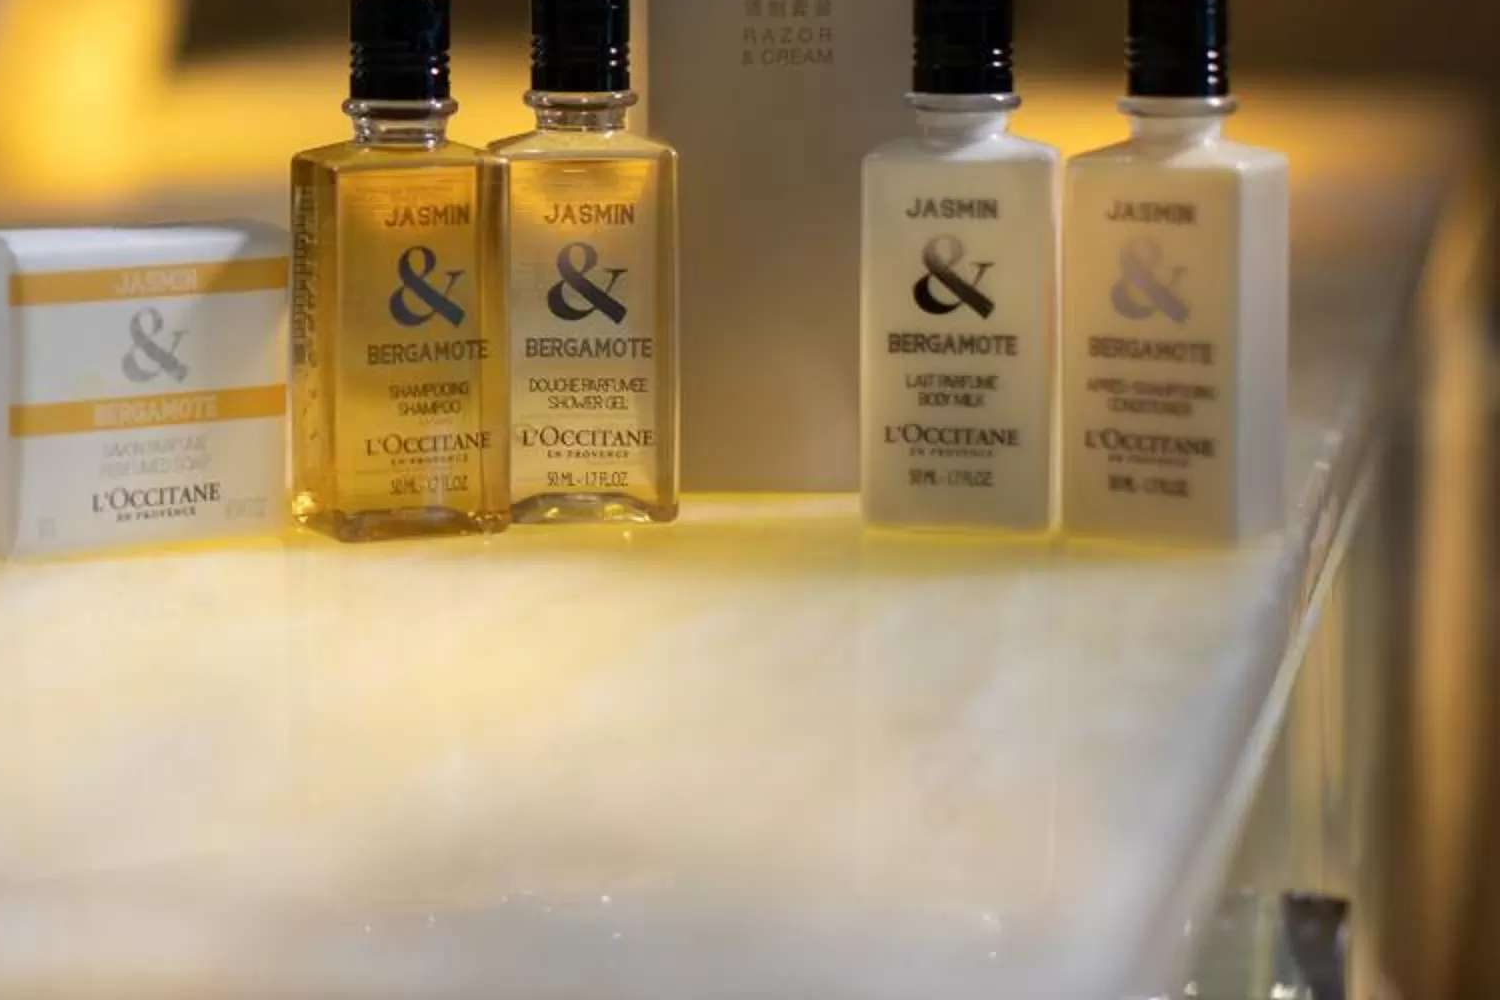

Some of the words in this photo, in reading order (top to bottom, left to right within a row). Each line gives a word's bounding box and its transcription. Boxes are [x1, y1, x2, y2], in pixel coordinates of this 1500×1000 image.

[743, 25, 833, 44] RAZOR
[761, 48, 833, 66] CREAM
[384, 204, 470, 227] JASMIN
[544, 204, 635, 224] JASMIN
[905, 197, 998, 219] JASMIN
[1106, 200, 1197, 225] JASMIN
[389, 245, 466, 328] &
[547, 241, 628, 324] &
[912, 234, 995, 319] &
[1110, 236, 1190, 323] &
[121, 307, 189, 383] &
[366, 339, 489, 365] BERGAMOTE
[525, 337, 652, 358] BERGAMOTE
[888, 333, 1018, 356] BERGAMOTE
[1088, 335, 1213, 365] BERGAMOTE
[389, 381, 469, 399] SHAMPOOING
[529, 377, 580, 392] DOUCHE
[94, 396, 218, 428] BERGAMOTE
[399, 400, 461, 416] SHAMPOO
[548, 395, 603, 409] SHOWER
[606, 395, 628, 410] GEL
[365, 431, 491, 456] L'OCCITANE
[522, 425, 653, 447] L'OCCITANE
[884, 424, 1019, 446] L'OCCITANE
[567, 450, 629, 458] PROVENCE
[92, 482, 221, 512] L'OCCITANE
